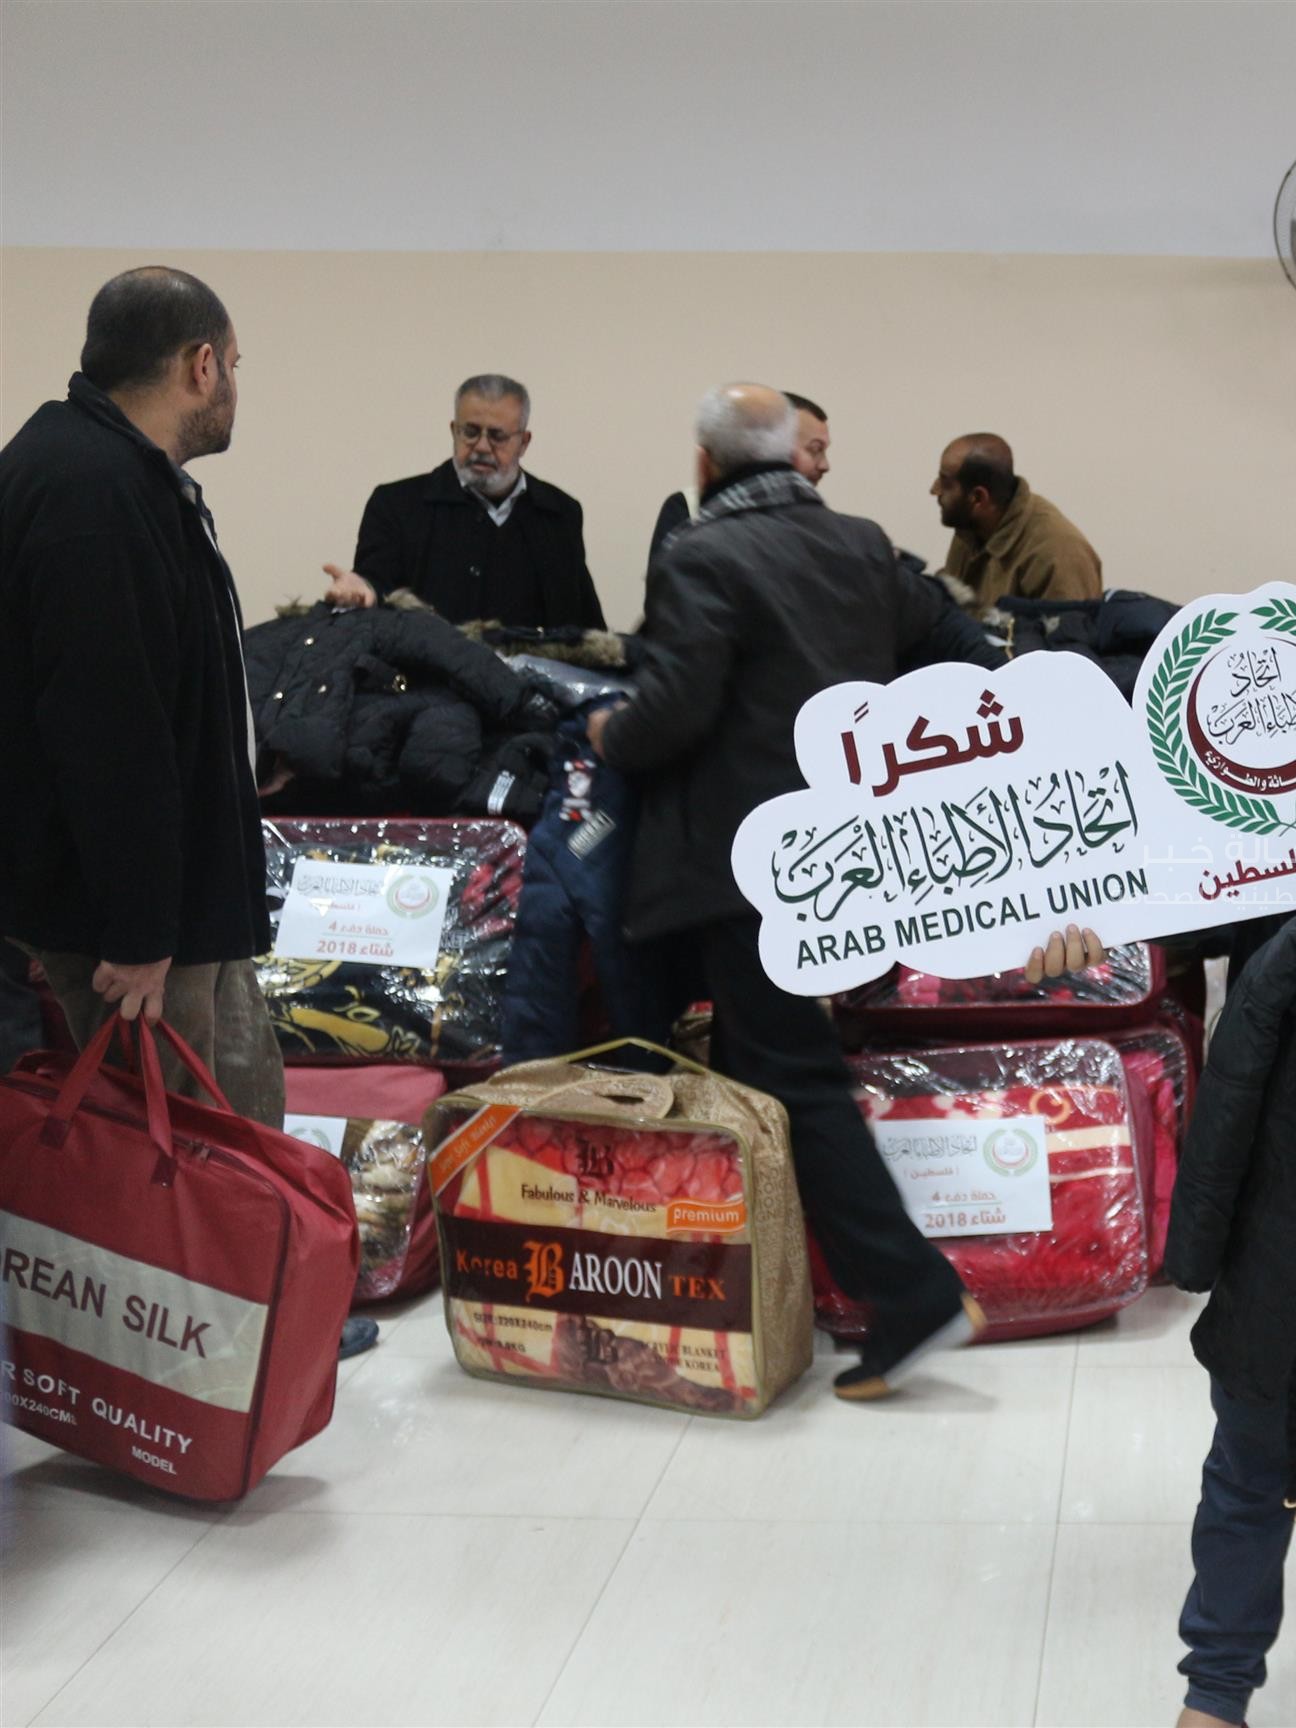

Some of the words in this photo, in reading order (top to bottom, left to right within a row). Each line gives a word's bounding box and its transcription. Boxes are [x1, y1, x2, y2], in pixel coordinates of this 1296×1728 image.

[797, 923, 886, 971] ARAB
[893, 895, 1041, 949] MEDICAL
[1046, 867, 1151, 915] UNION
[315, 939, 357, 956] 2018
[520, 1182, 576, 1205] Fabulous
[593, 1191, 657, 1214] Marvelous
[672, 1205, 741, 1225] premium
[924, 1210, 968, 1229] 2018
[671, 1272, 726, 1301] TEX
[122, 1295, 212, 1359] SILK
[23, 1367, 81, 1406] SOFT
[91, 1396, 194, 1456] QUALITY
[131, 1445, 178, 1475] MODEL
